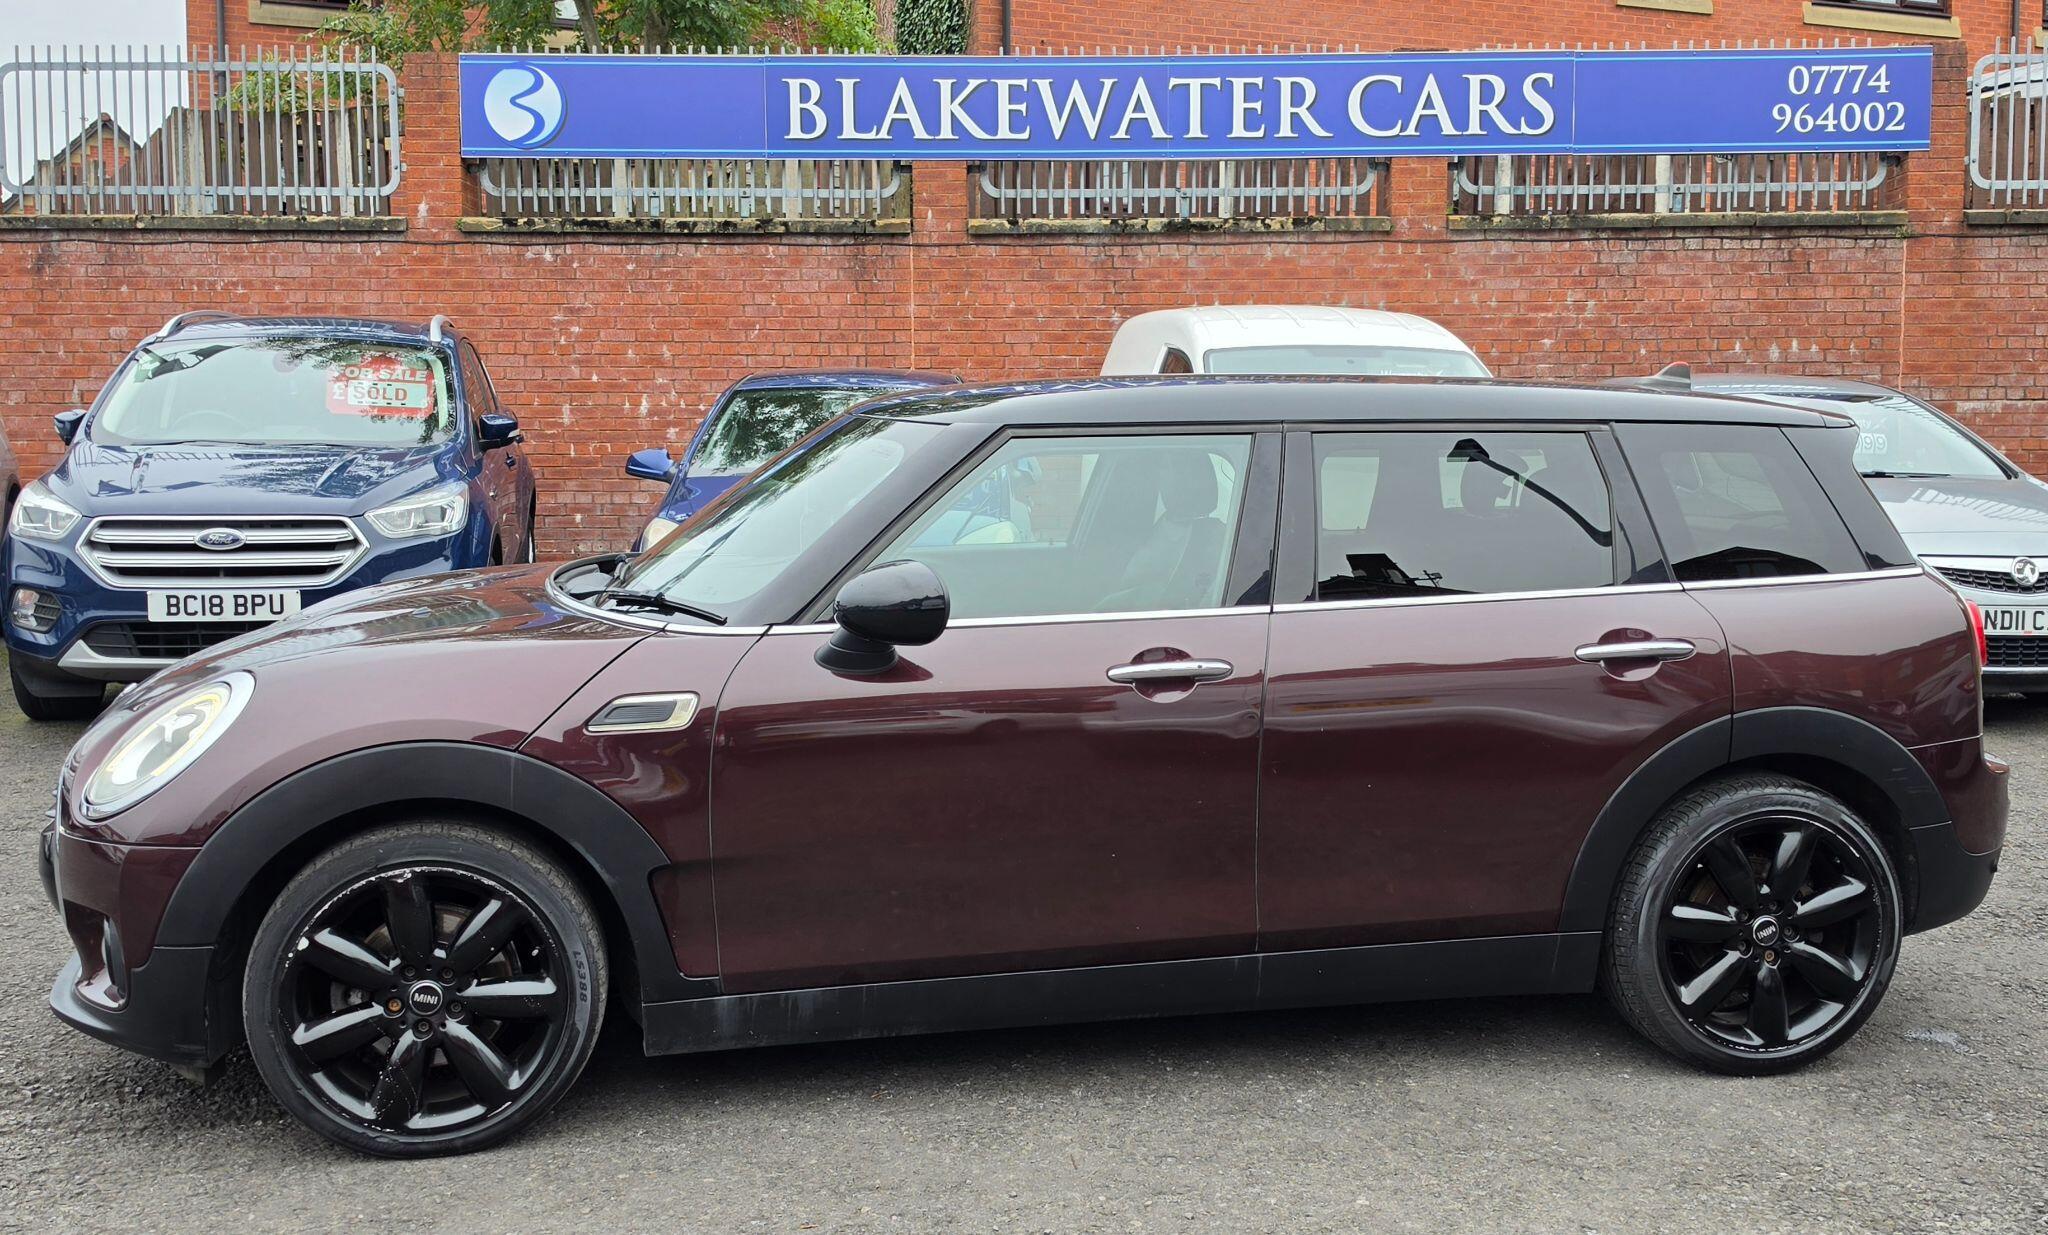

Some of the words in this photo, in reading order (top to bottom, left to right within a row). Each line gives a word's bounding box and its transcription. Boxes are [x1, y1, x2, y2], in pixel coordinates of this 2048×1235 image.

[1788, 63, 1891, 95] 07774
[781, 75, 1335, 140] BLAKEWATER
[1347, 72, 1555, 138] CARS
[1772, 101, 1906, 133] 964002
[338, 365, 374, 379] FOR
[380, 368, 428, 381] SALE
[353, 385, 408, 401] SOLD
[1857, 435, 1886, 450] 99
[207, 533, 234, 545] Ford
[165, 594, 225, 617] BC18
[233, 593, 285, 616] BPU
[1984, 609, 2026, 631] ND11
[2033, 610, 2048, 631] C
[1757, 925, 1776, 940] MINI
[571, 950, 588, 1003] LS388
[413, 992, 438, 1005] MINI
